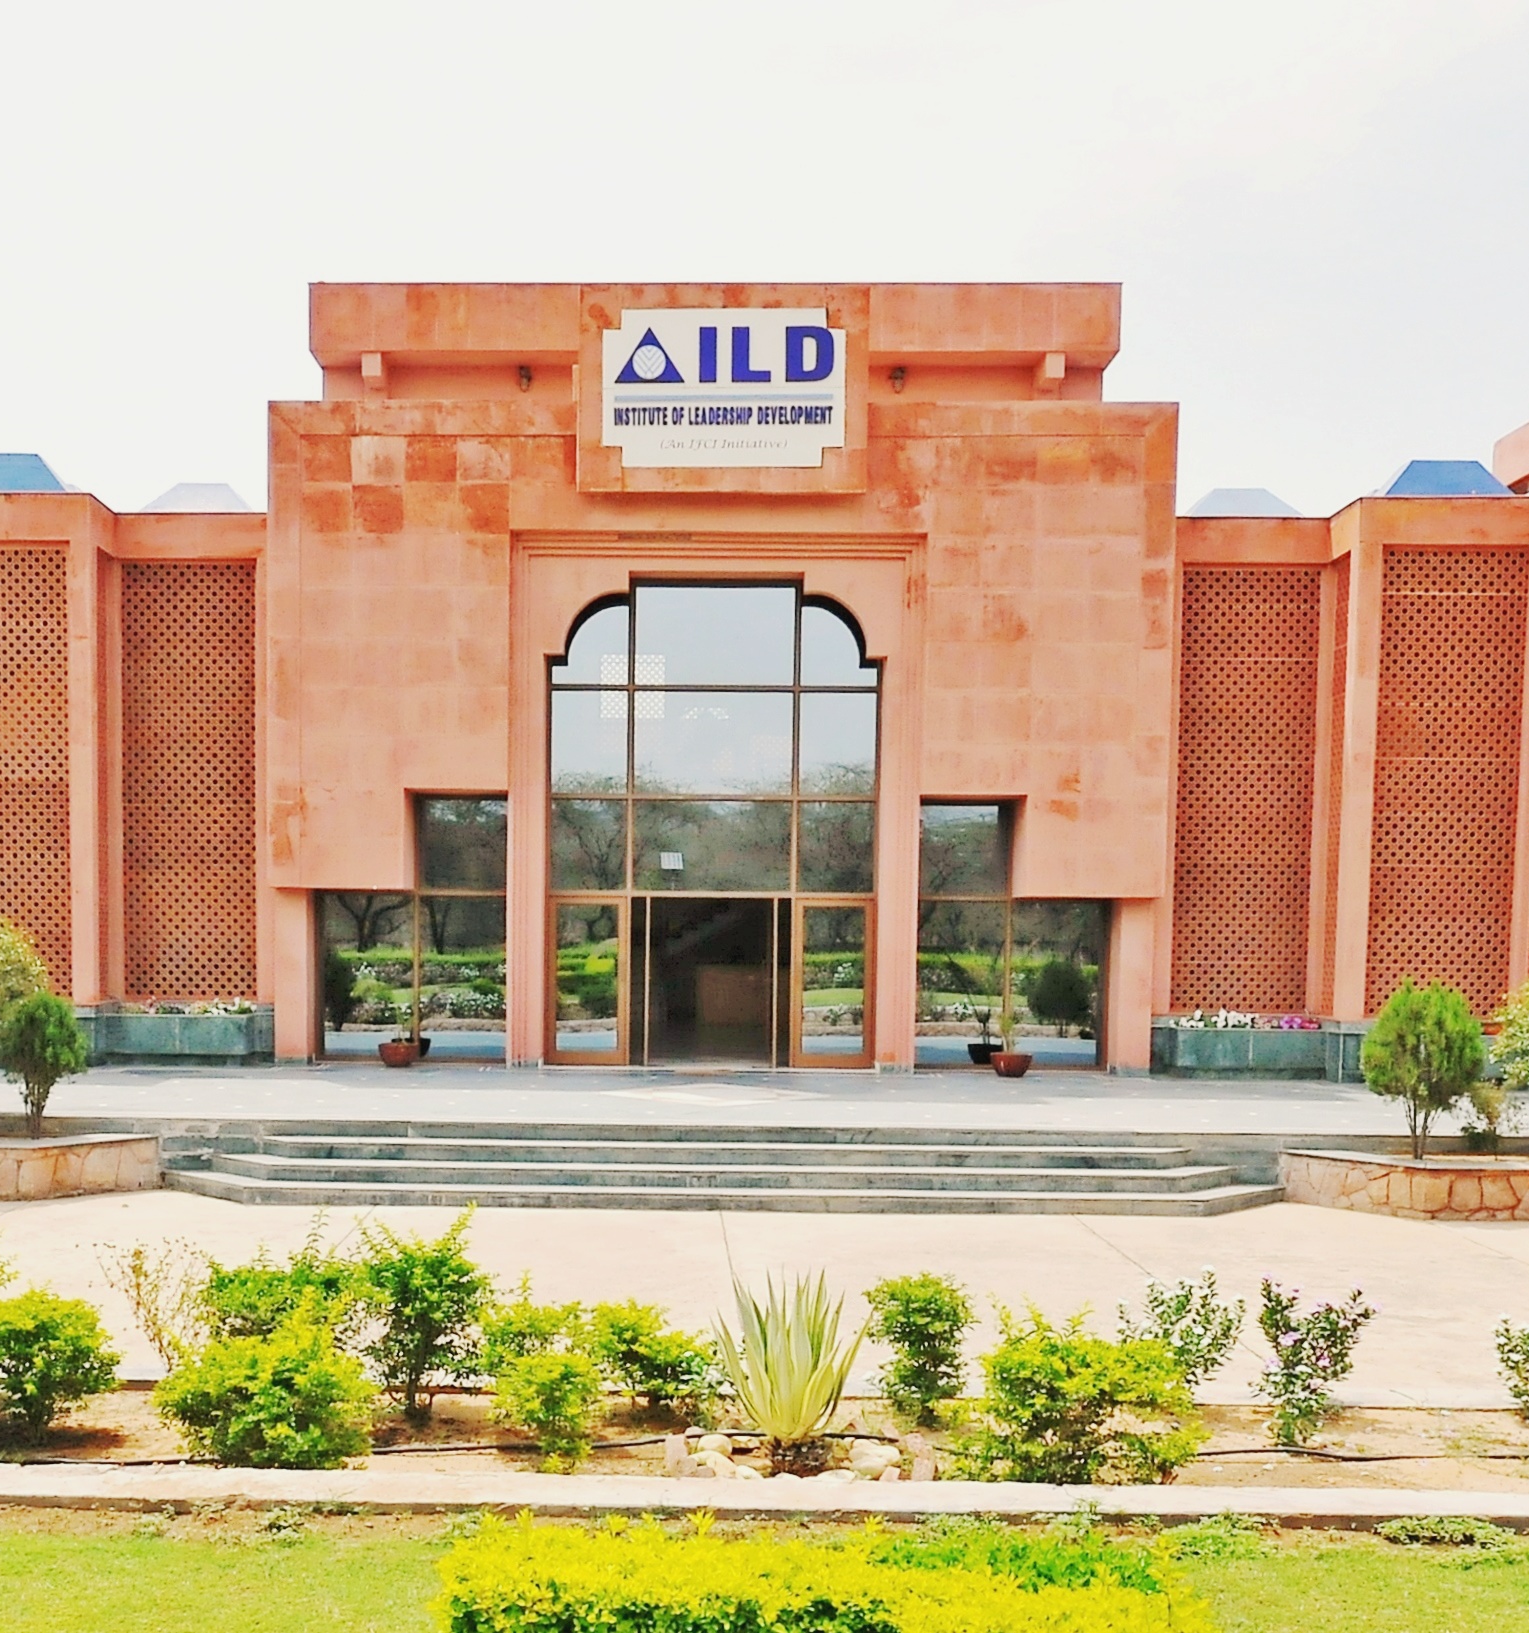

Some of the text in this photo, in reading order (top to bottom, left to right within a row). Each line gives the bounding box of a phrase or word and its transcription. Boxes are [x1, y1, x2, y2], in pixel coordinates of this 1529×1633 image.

[699, 326, 834, 383] ILD
[614, 405, 833, 426] INSTITUTE OF LEADERSHIP DEVELOPMENT
